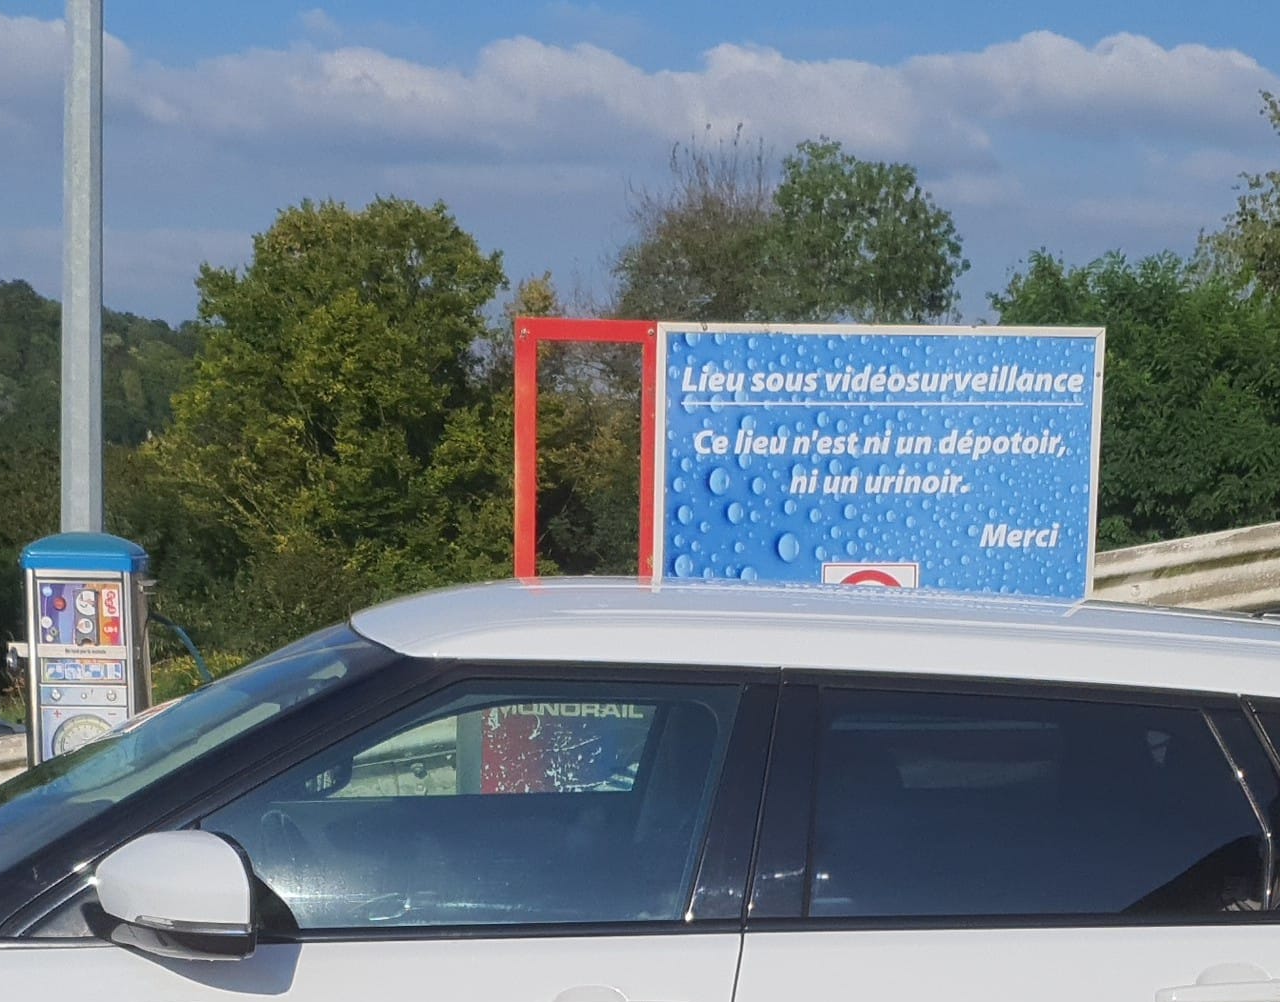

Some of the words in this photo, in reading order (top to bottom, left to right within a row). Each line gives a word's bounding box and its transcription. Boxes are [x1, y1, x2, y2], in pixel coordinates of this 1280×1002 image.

[681, 365, 745, 393] Lieu
[750, 371, 818, 393] sous
[825, 363, 1085, 393] vidéosurveillance
[693, 429, 729, 455] Ce
[734, 428, 788, 455] lieu
[792, 429, 859, 455] n'est
[863, 428, 892, 455] ni
[897, 435, 932, 455] un
[938, 428, 1067, 460] dépotoir,
[789, 468, 819, 495] ni
[823, 474, 858, 495] un
[864, 468, 971, 495] urinoir.
[979, 522, 1060, 548] Merci
